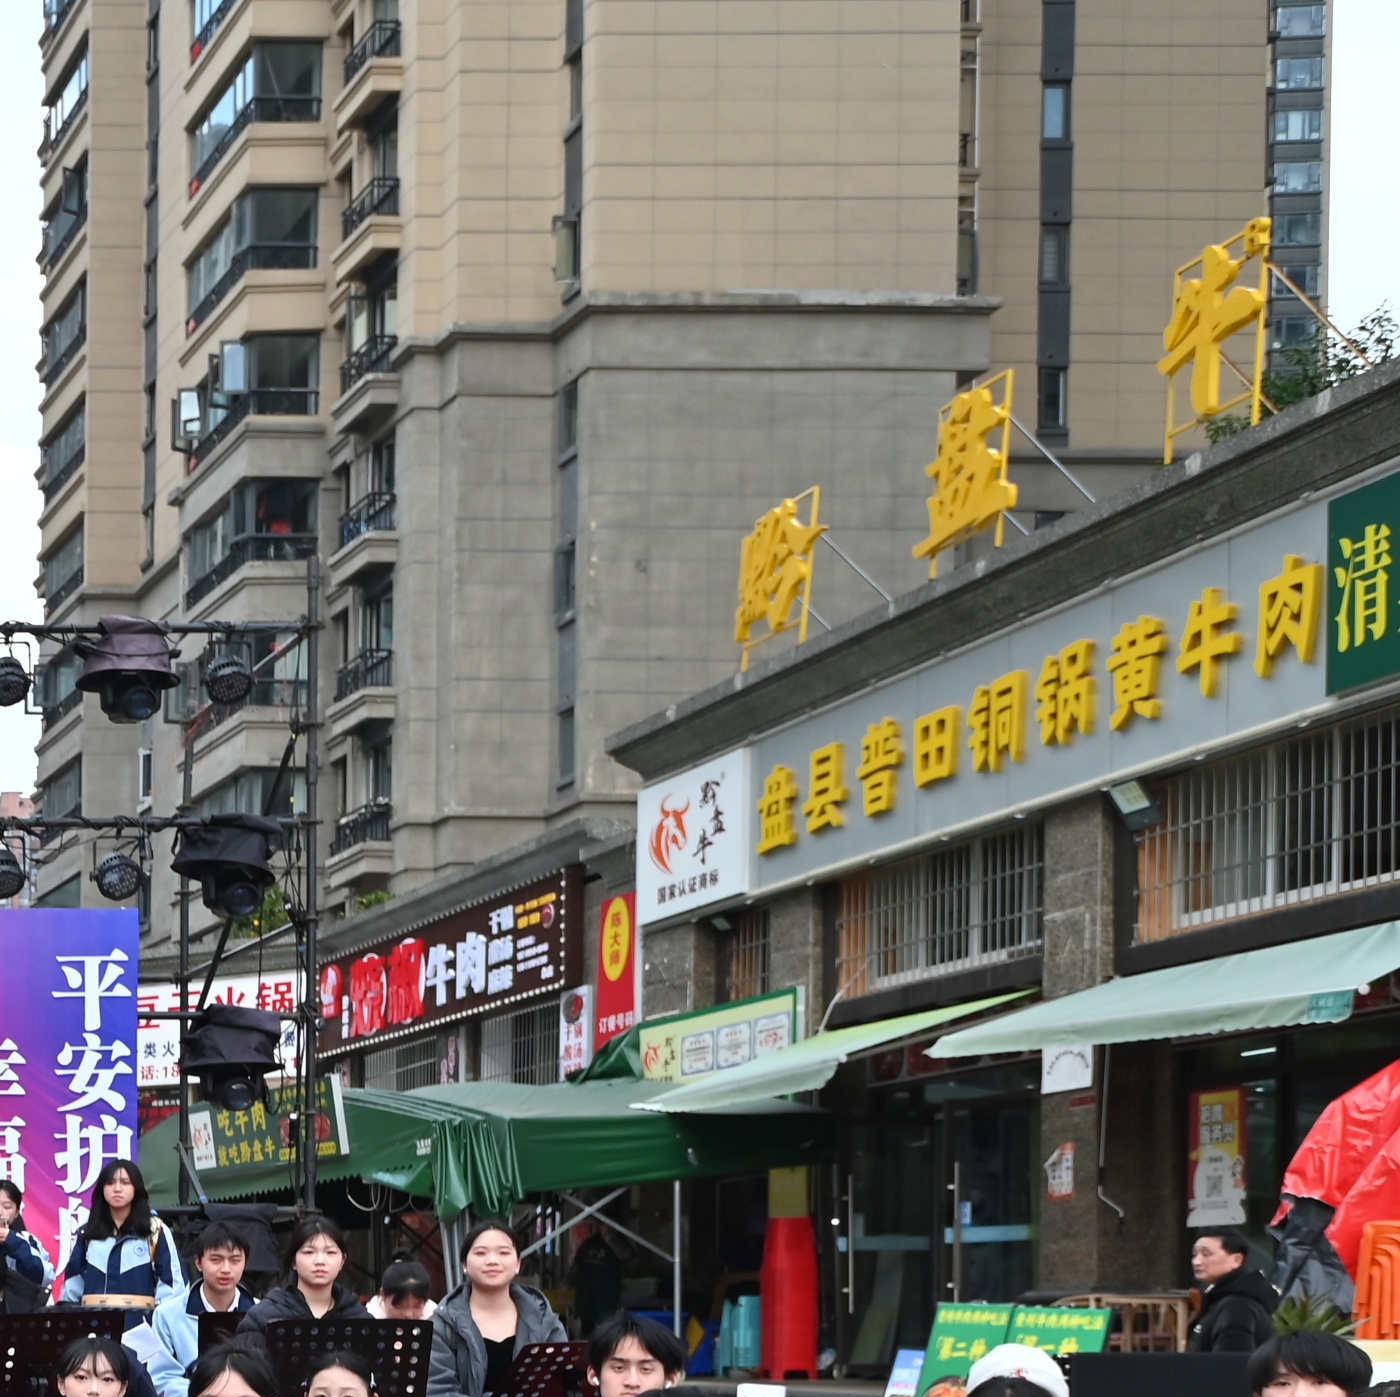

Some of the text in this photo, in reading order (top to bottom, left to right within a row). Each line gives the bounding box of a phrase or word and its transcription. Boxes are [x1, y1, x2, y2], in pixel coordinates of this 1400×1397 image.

[1333, 522, 1400, 654] 清
[755, 553, 1324, 856] 盘县普田铜锅黄牛肉
[656, 869, 719, 905] 国家认证商标
